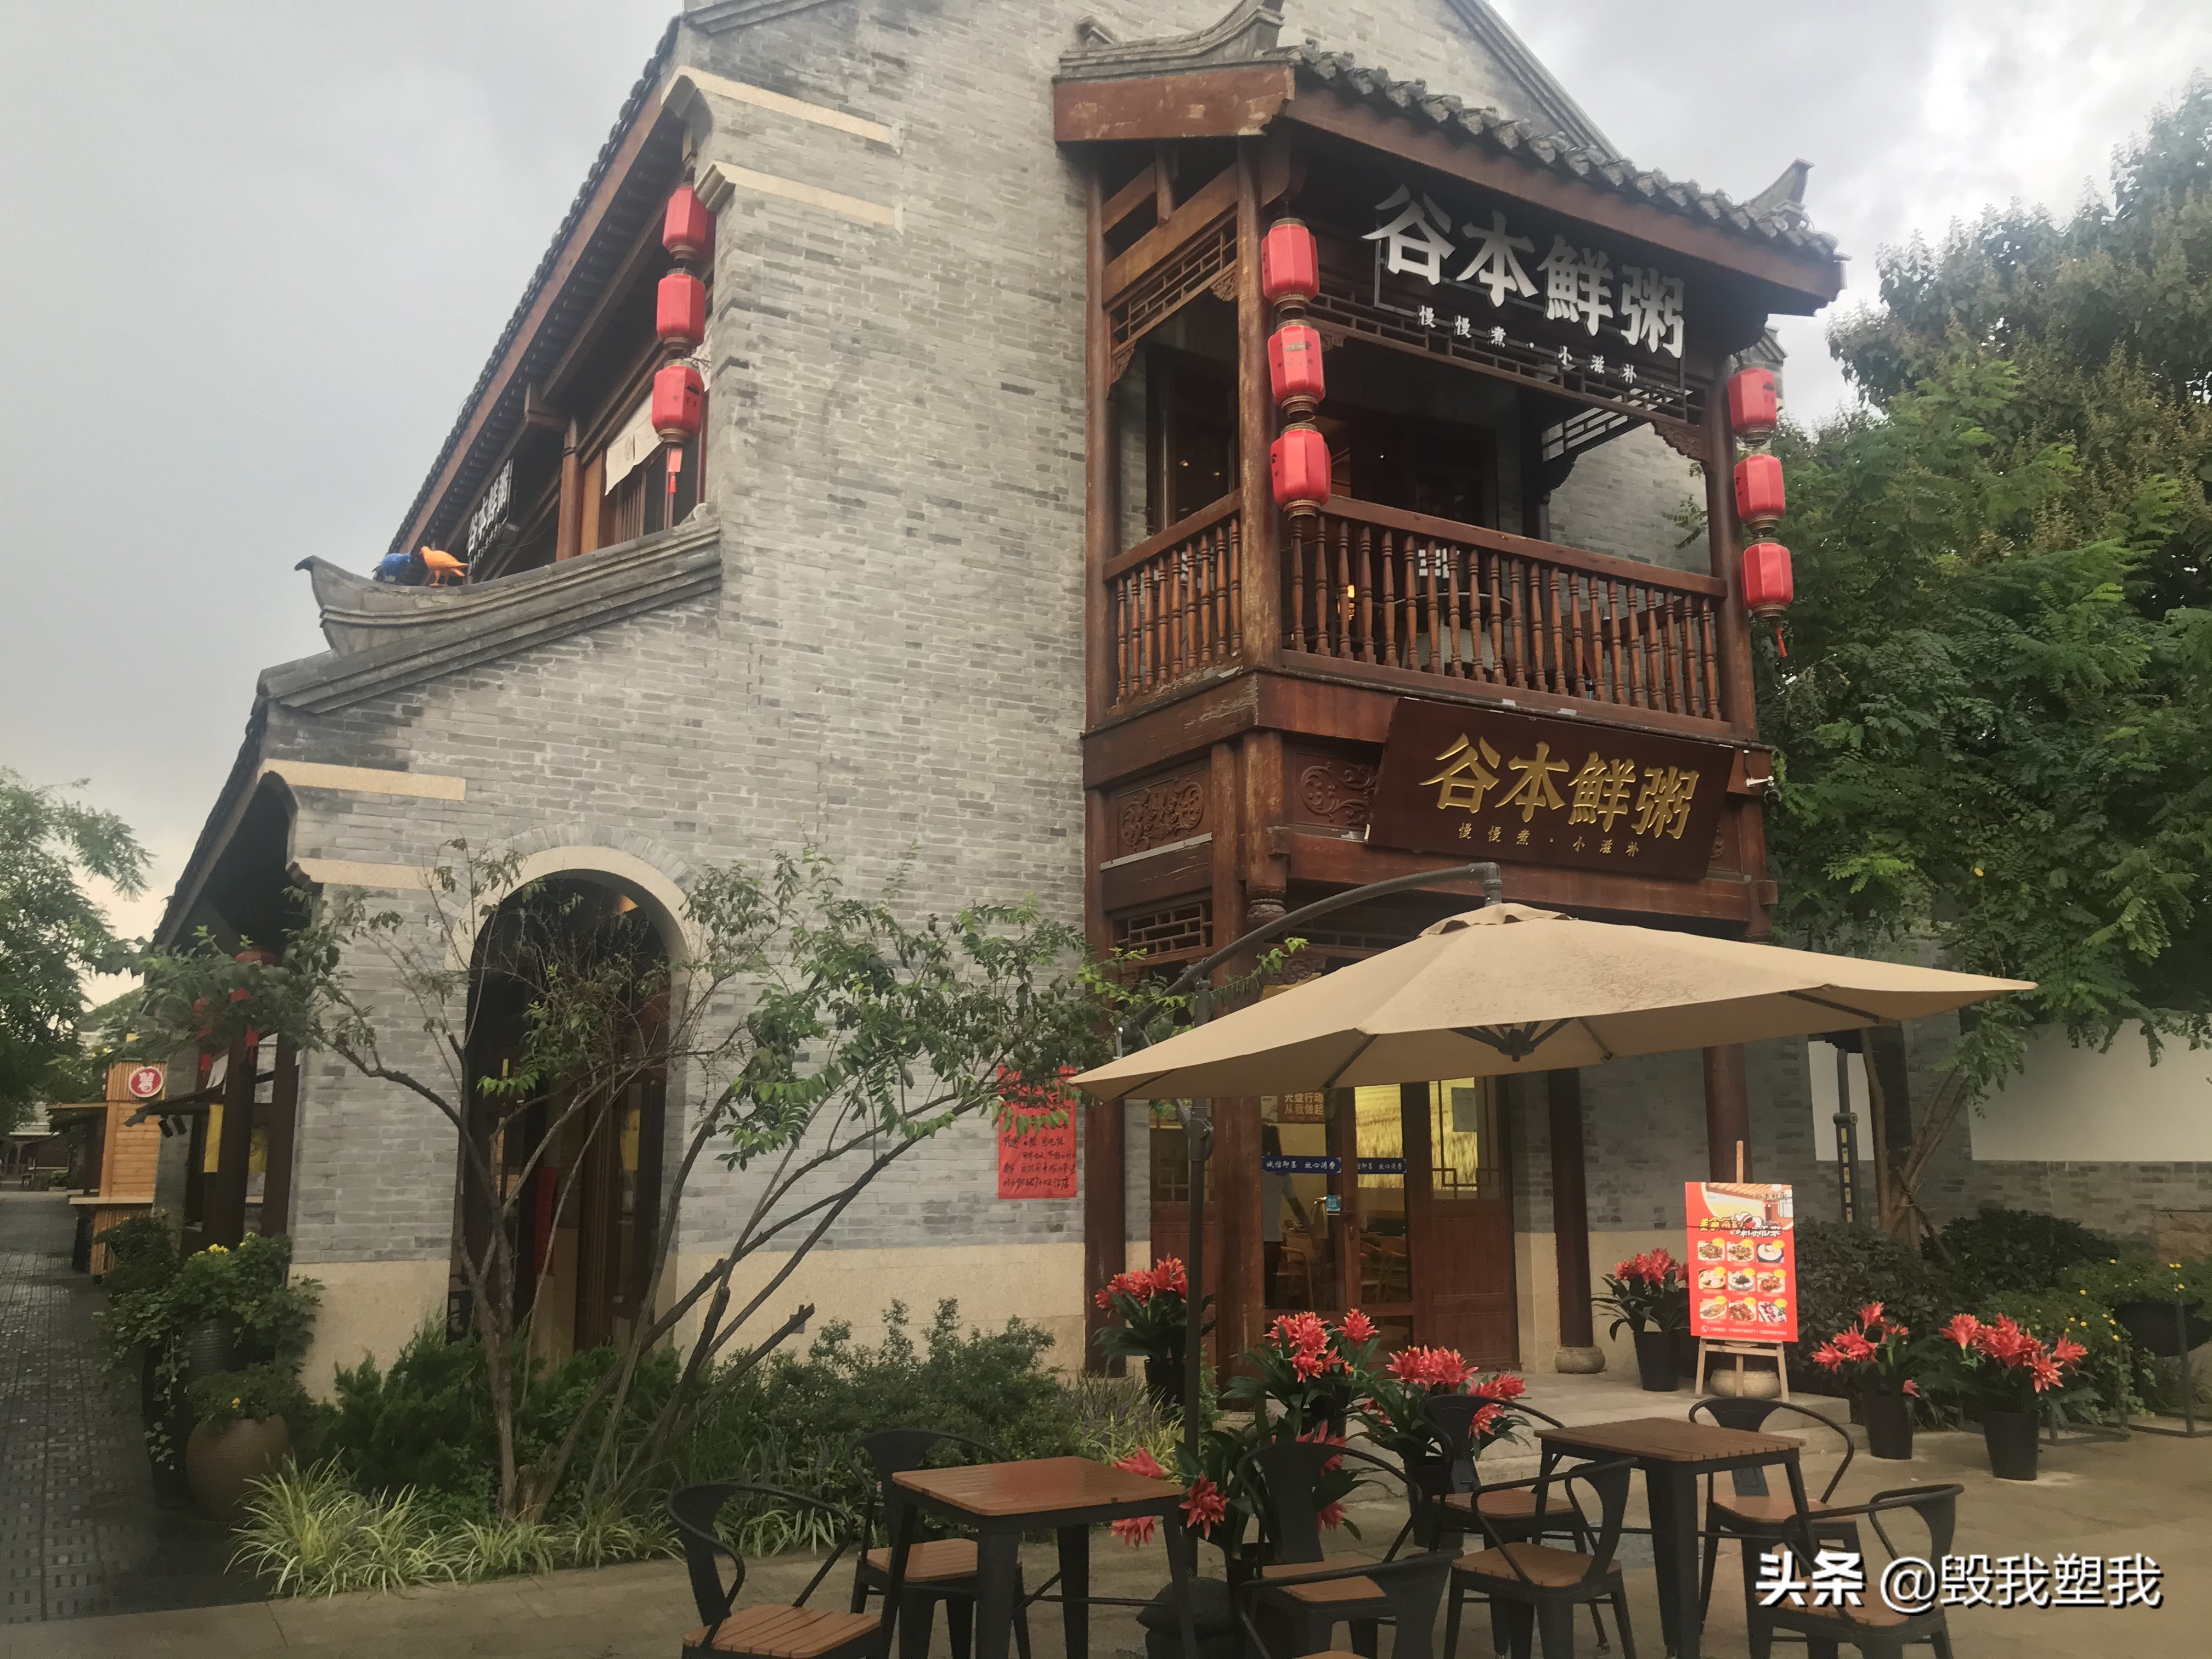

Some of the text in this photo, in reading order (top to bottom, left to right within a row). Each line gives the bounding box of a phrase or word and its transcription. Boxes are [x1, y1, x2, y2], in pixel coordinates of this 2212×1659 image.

[1284, 1104, 1323, 1115] 从我做起
[1305, 1160, 1336, 1170] 放心消费
